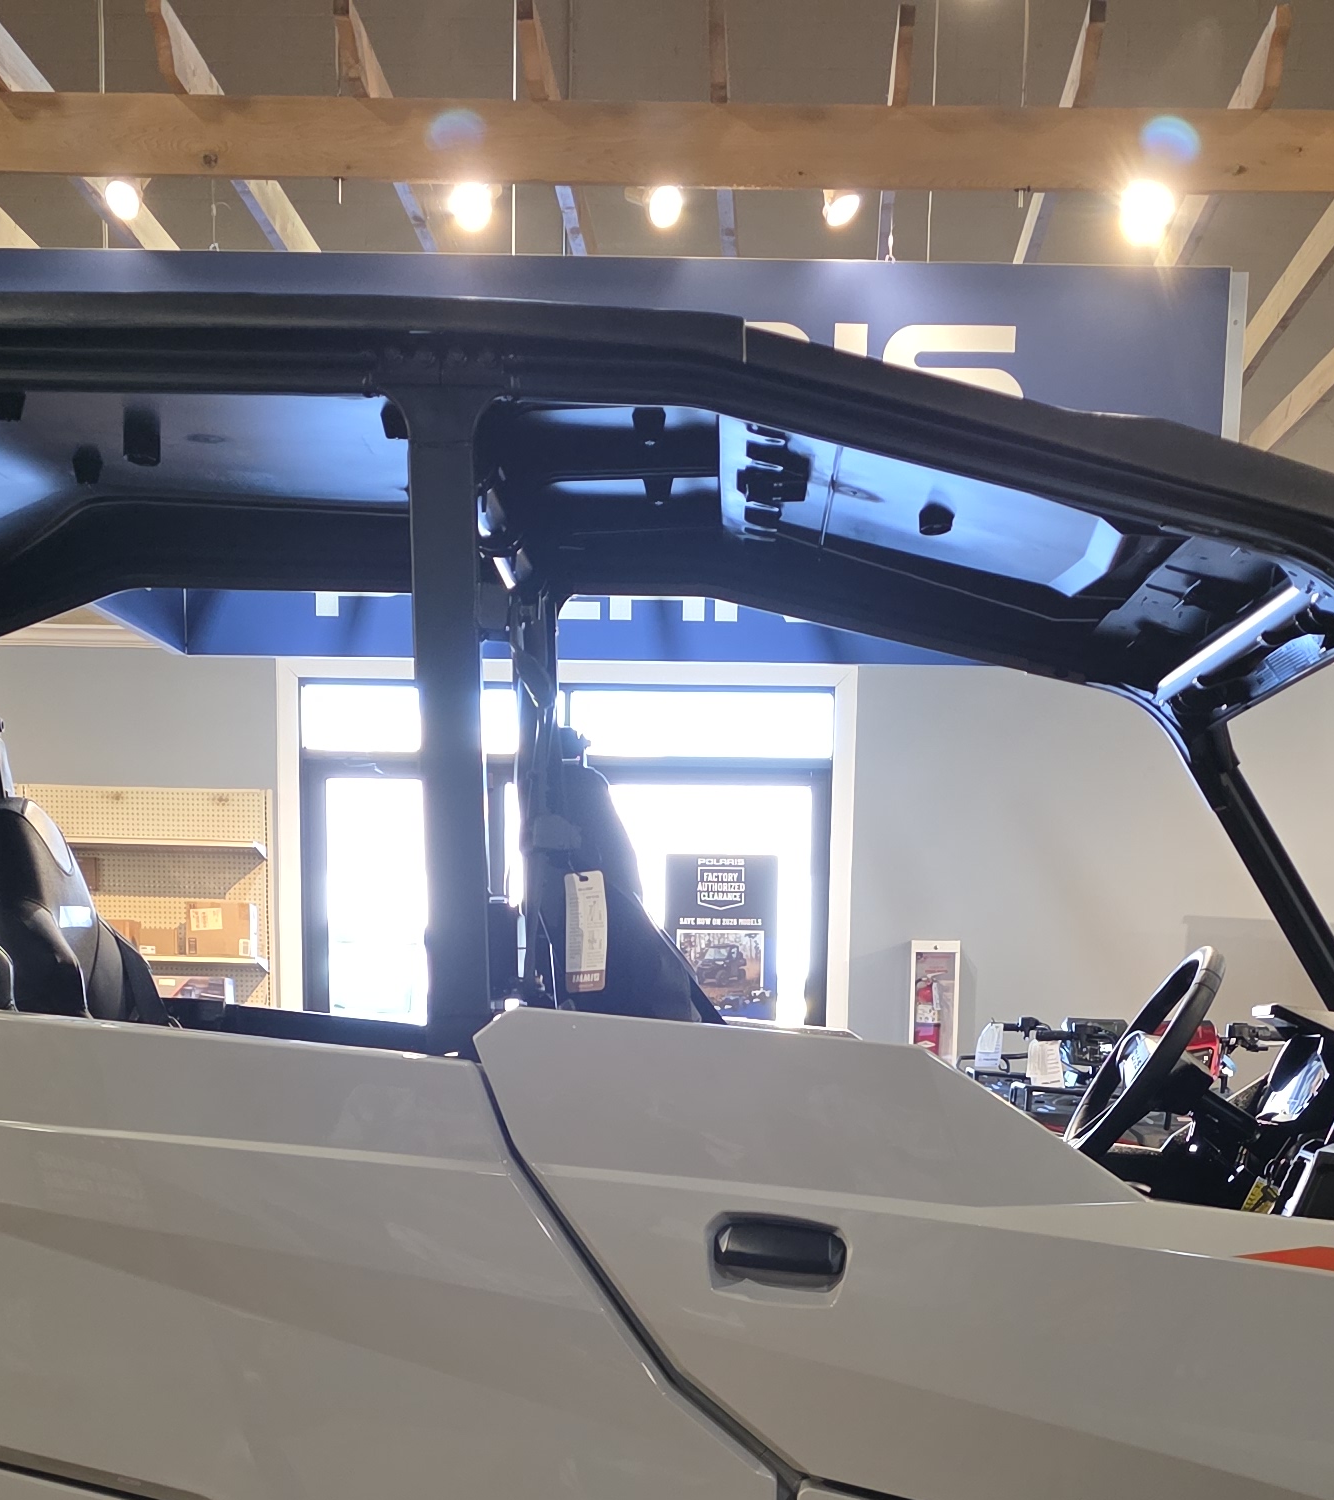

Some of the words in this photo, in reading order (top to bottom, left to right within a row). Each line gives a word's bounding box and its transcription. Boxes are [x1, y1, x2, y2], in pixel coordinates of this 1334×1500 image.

[698, 858, 745, 866] POLARIS
[703, 872, 739, 882] FACTORY
[697, 881, 746, 892] AUTHORIZED
[700, 892, 742, 901] CLEARANCE
